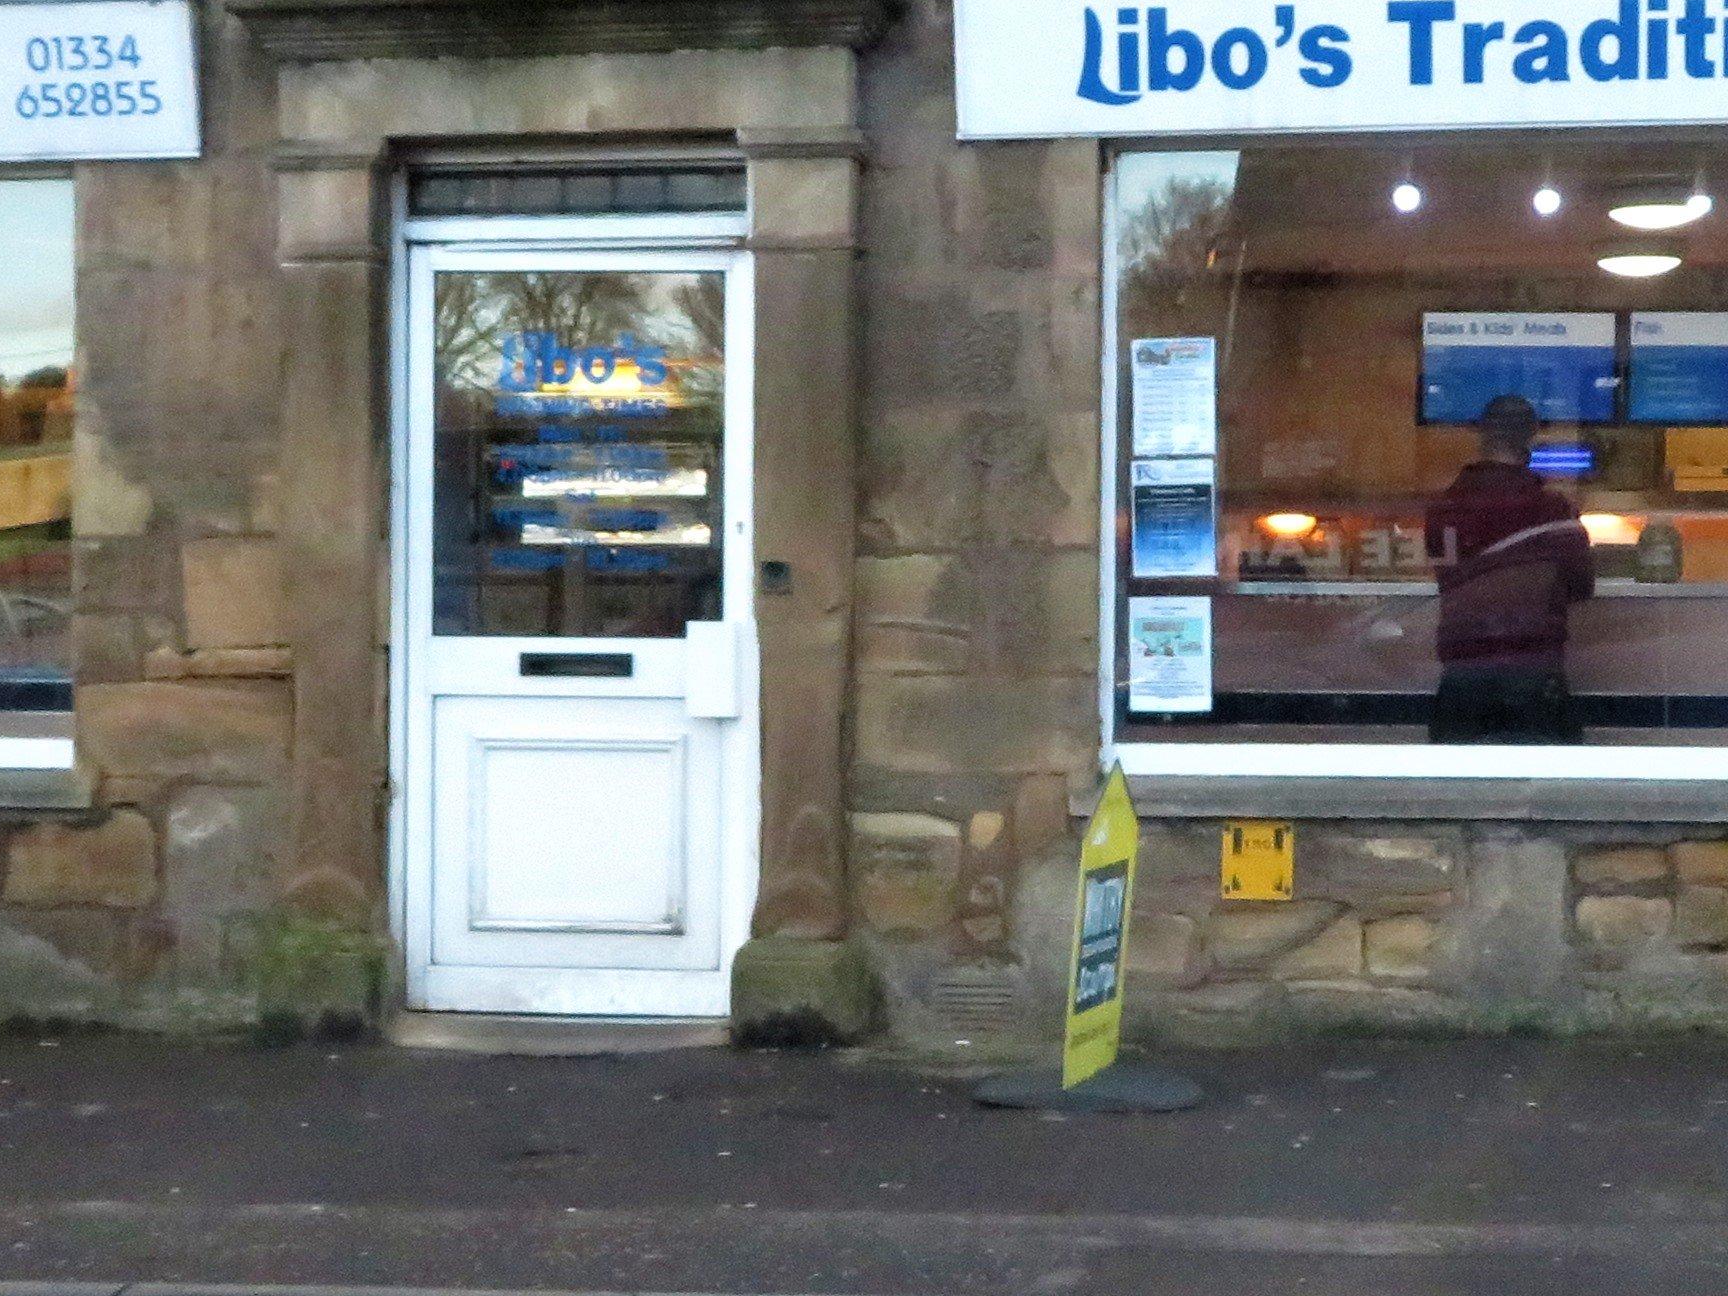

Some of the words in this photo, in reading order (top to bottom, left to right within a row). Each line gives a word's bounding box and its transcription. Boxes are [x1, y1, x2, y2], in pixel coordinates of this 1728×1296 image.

[25, 35, 142, 74] 01334
[1076, 3, 1354, 108] Libo's
[14, 79, 163, 121] 652855
